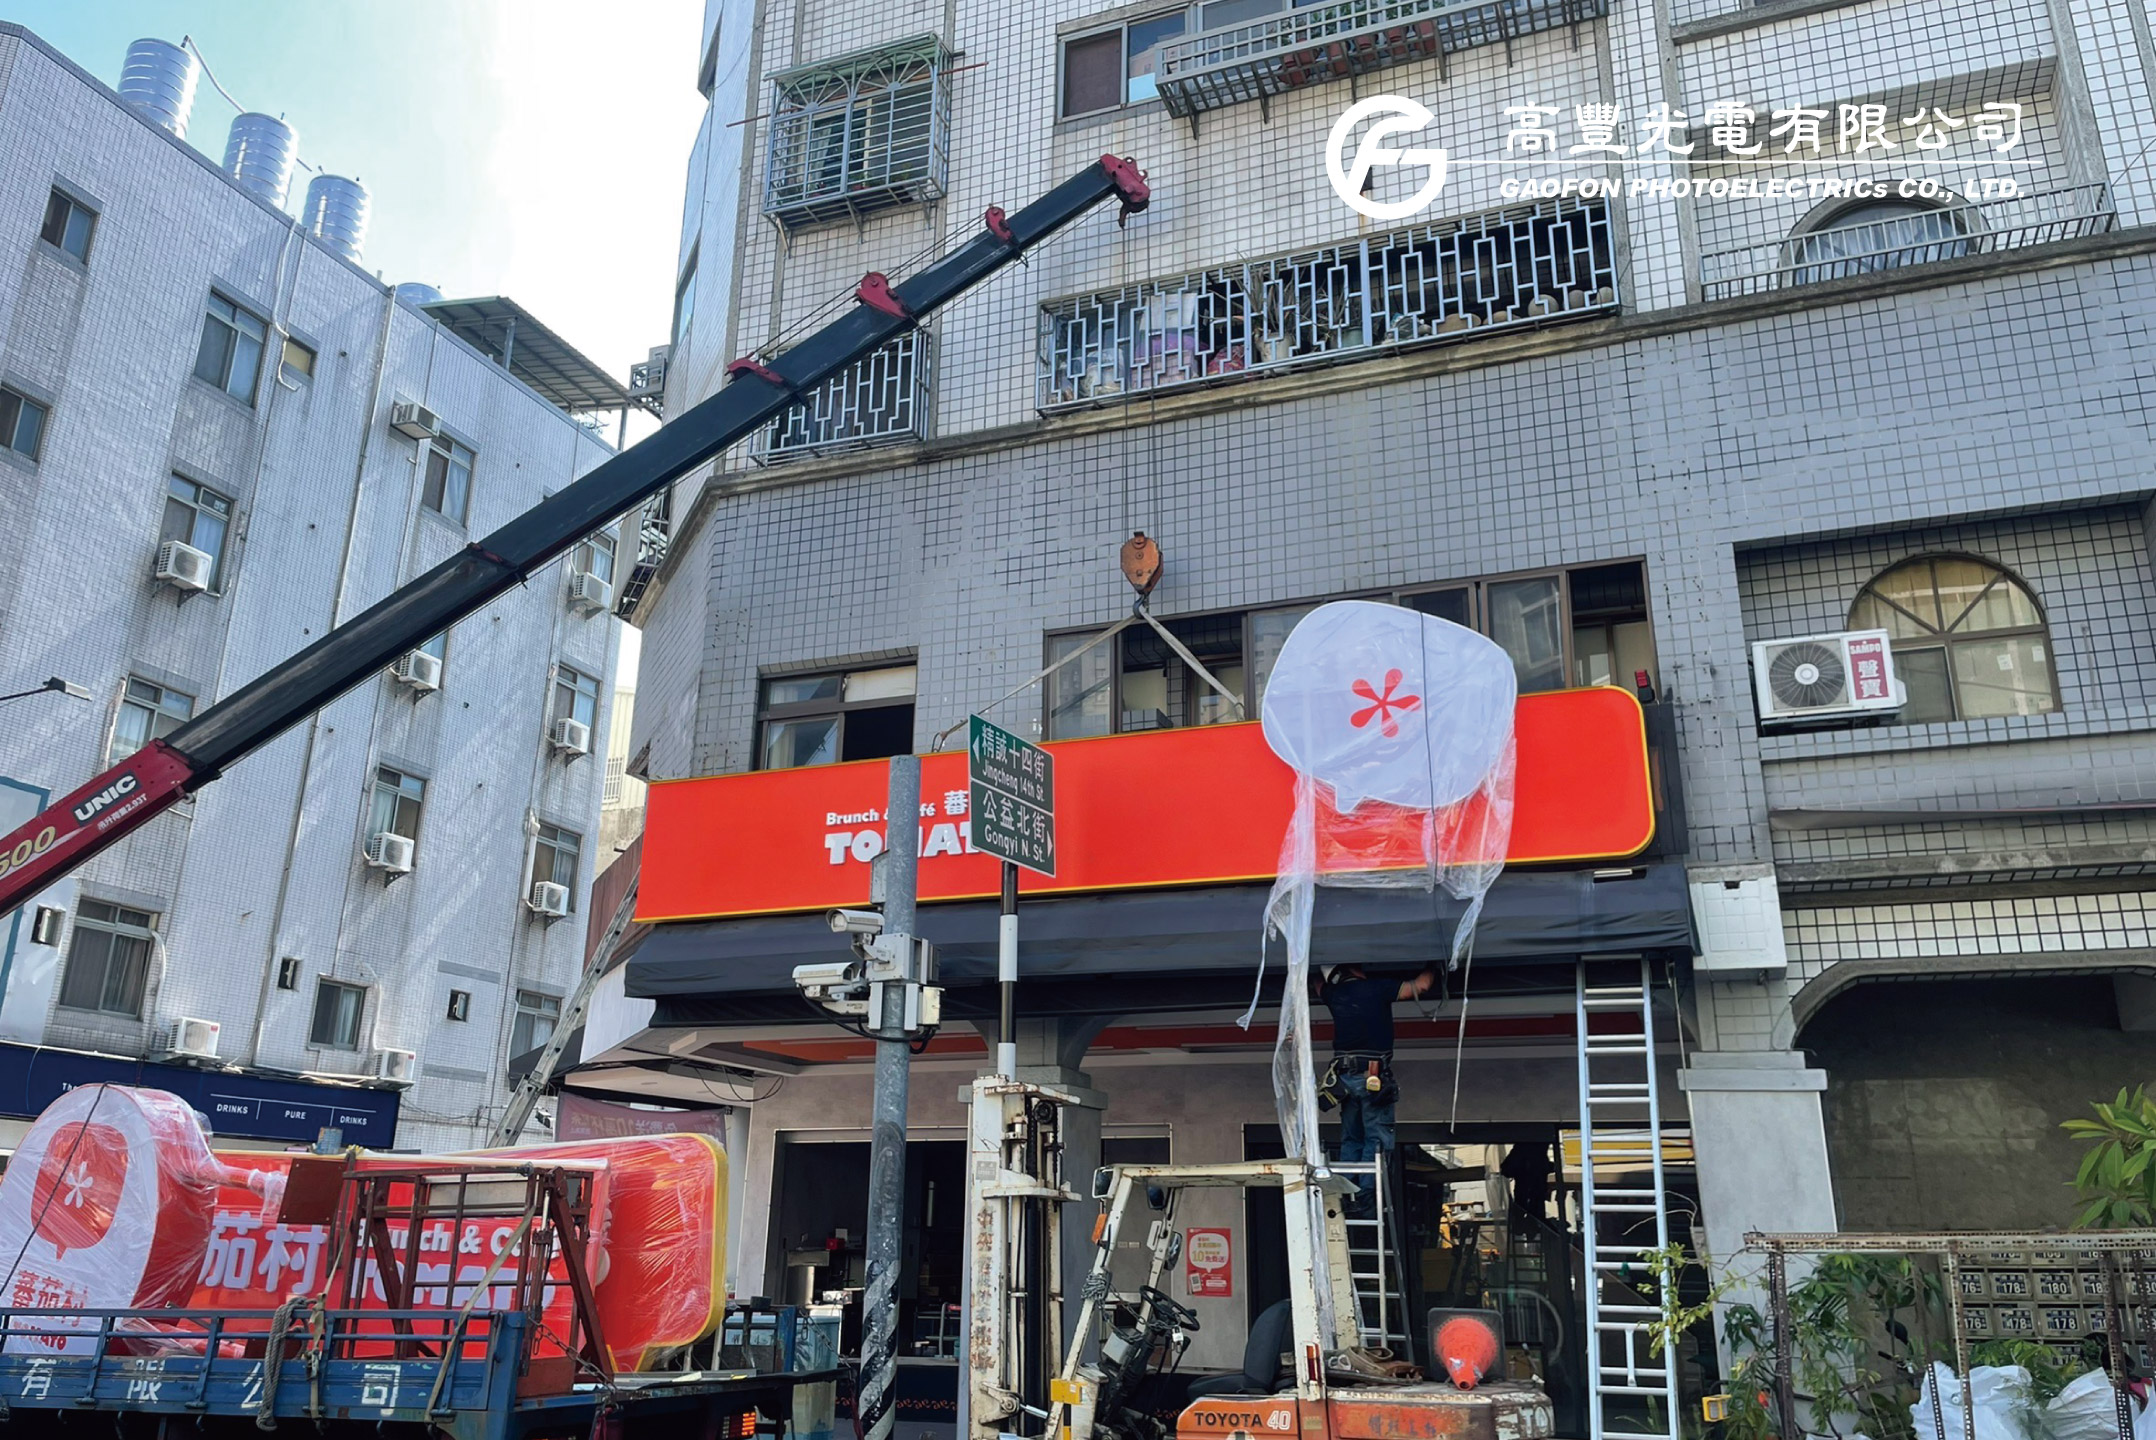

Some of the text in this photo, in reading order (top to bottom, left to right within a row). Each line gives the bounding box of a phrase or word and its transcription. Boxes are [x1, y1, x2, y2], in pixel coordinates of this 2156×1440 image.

[1850, 642, 1881, 655] SAMPO
[982, 723, 1044, 782] 精誠十四街
[982, 759, 1018, 796] Jingcheng
[1020, 776, 1035, 798] 14th
[74, 775, 136, 821] UNIC
[826, 808, 880, 826] Brunch
[983, 790, 1045, 843] 公益北街
[825, 821, 980, 865] TOAT
[985, 824, 1018, 856] Gongyi
[216, 1103, 368, 1126] DRINKS PURE DRINKS
[459, 1225, 482, 1255] &
[1962, 1282, 1977, 1293] 76
[2002, 1282, 2021, 1293] 178
[2047, 1282, 2067, 1294] 180
[2054, 1318, 2077, 1330] 178
[1194, 1412, 1264, 1428] TOYOTA
[1267, 1410, 1292, 1431] 40
